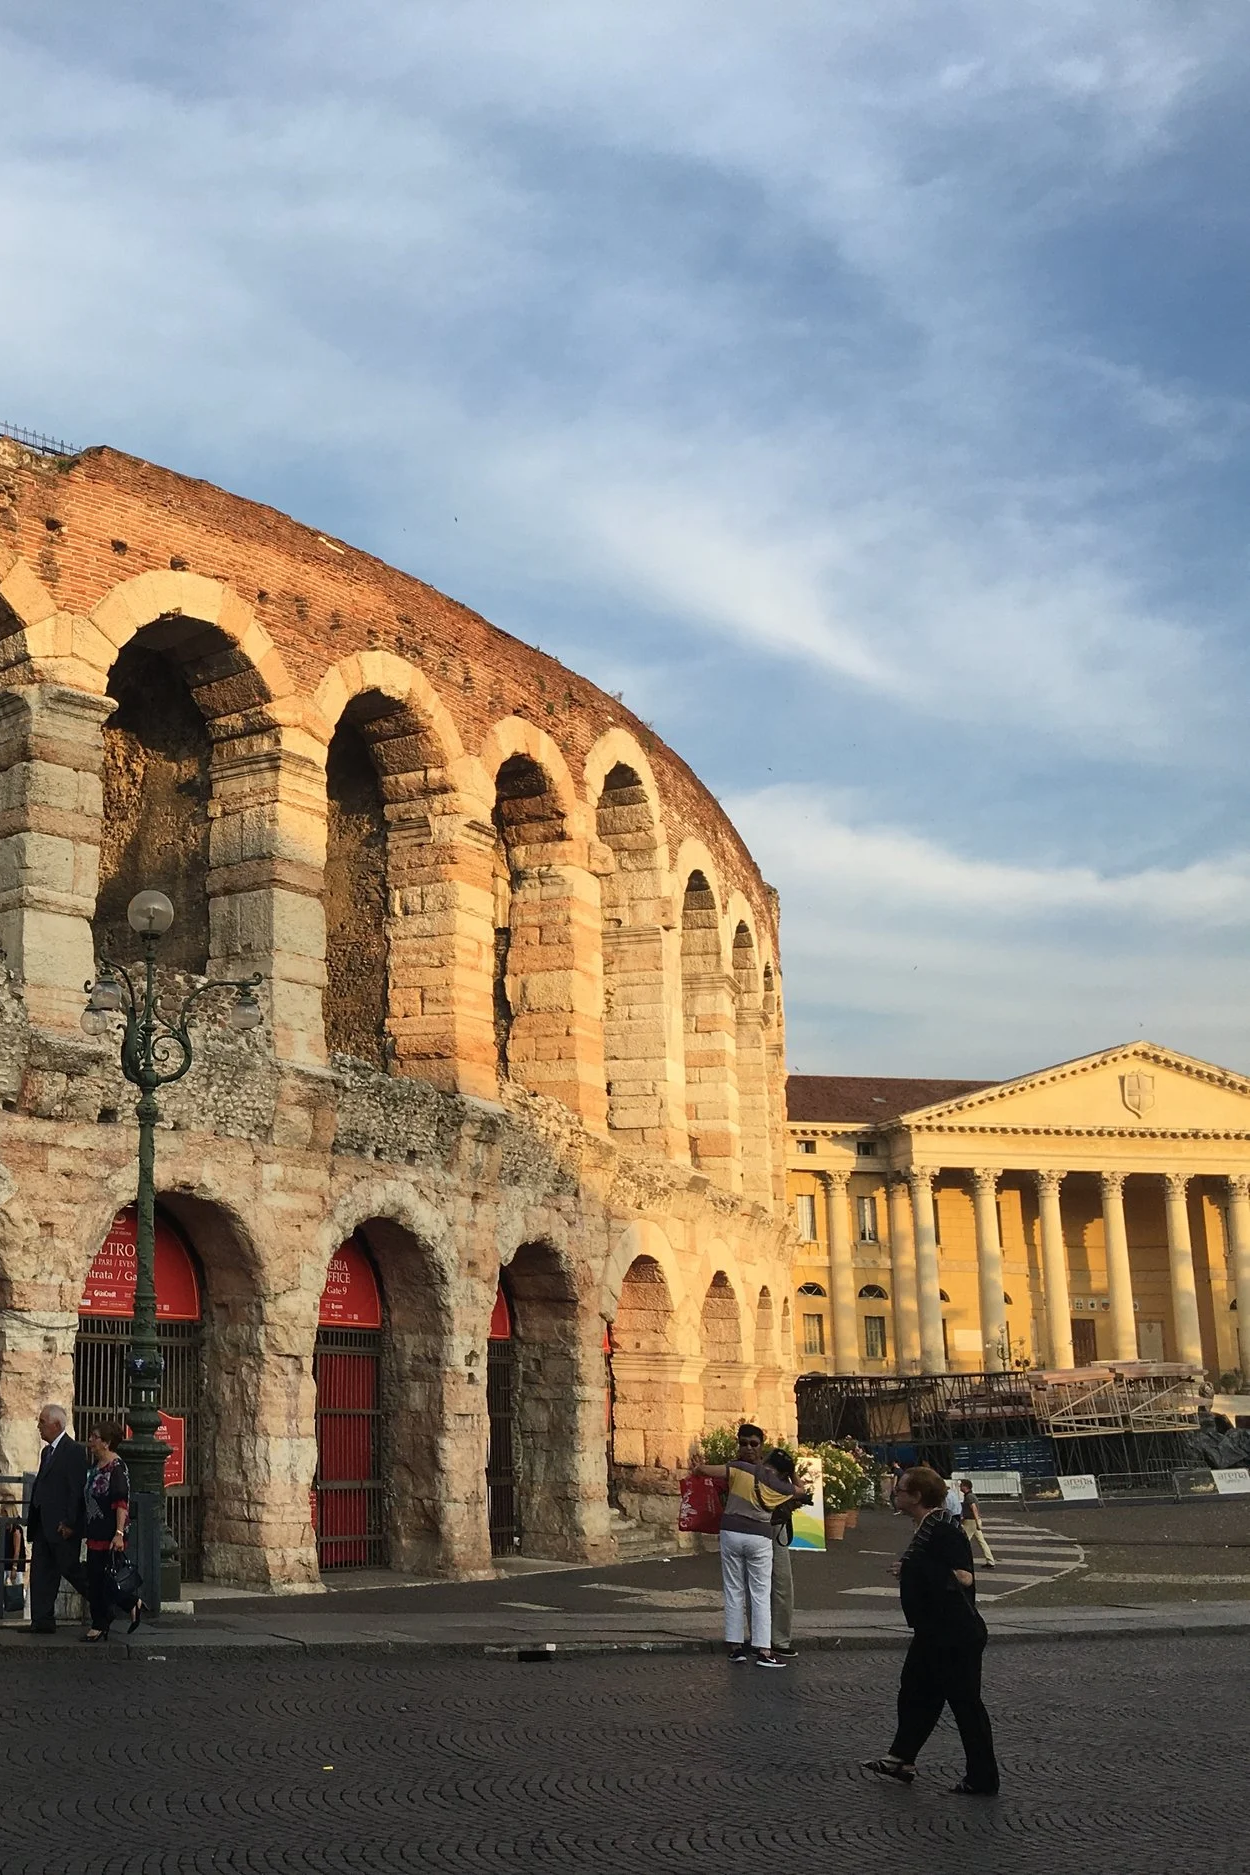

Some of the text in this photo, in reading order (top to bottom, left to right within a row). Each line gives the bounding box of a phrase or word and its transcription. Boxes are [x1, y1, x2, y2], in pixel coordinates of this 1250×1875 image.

[329, 1260, 348, 1271] ERIA
[87, 1269, 113, 1280] ntrata
[124, 1271, 137, 1281] Ga
[328, 1271, 351, 1284] FFICE
